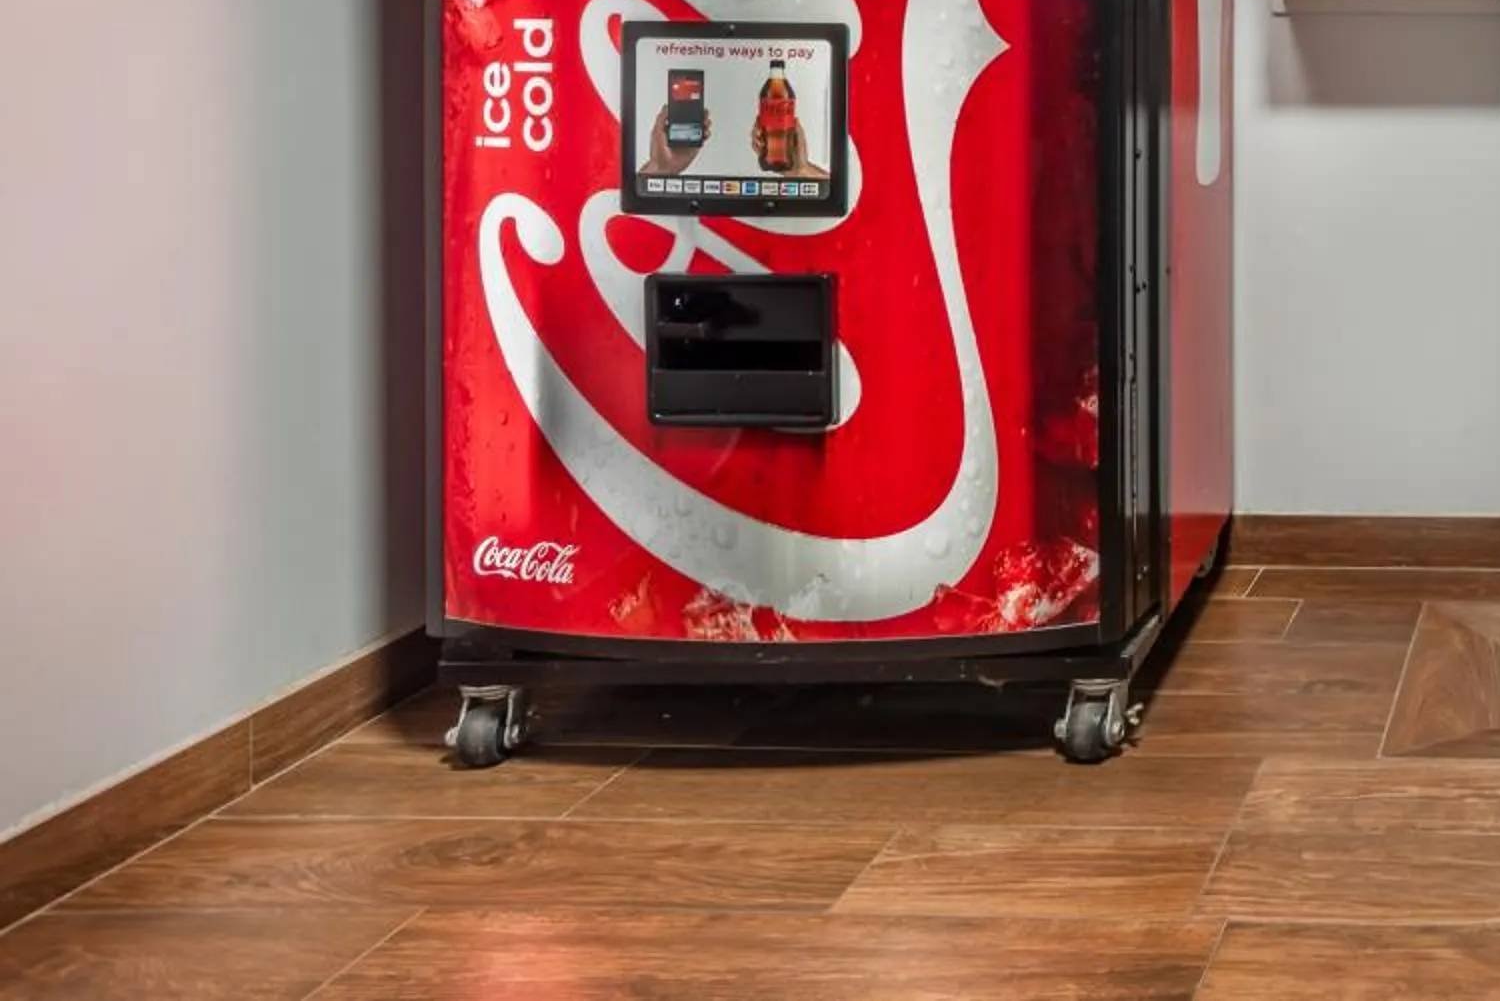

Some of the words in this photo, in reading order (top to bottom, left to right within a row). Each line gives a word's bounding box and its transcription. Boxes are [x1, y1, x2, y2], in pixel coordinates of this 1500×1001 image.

[513, 17, 553, 152] cold
[656, 43, 725, 58] refreshing
[729, 46, 764, 59] ways
[768, 46, 784, 57] to
[787, 48, 816, 60] pay
[475, 61, 511, 148] ice
[473, 536, 581, 584] Coca-Cola
